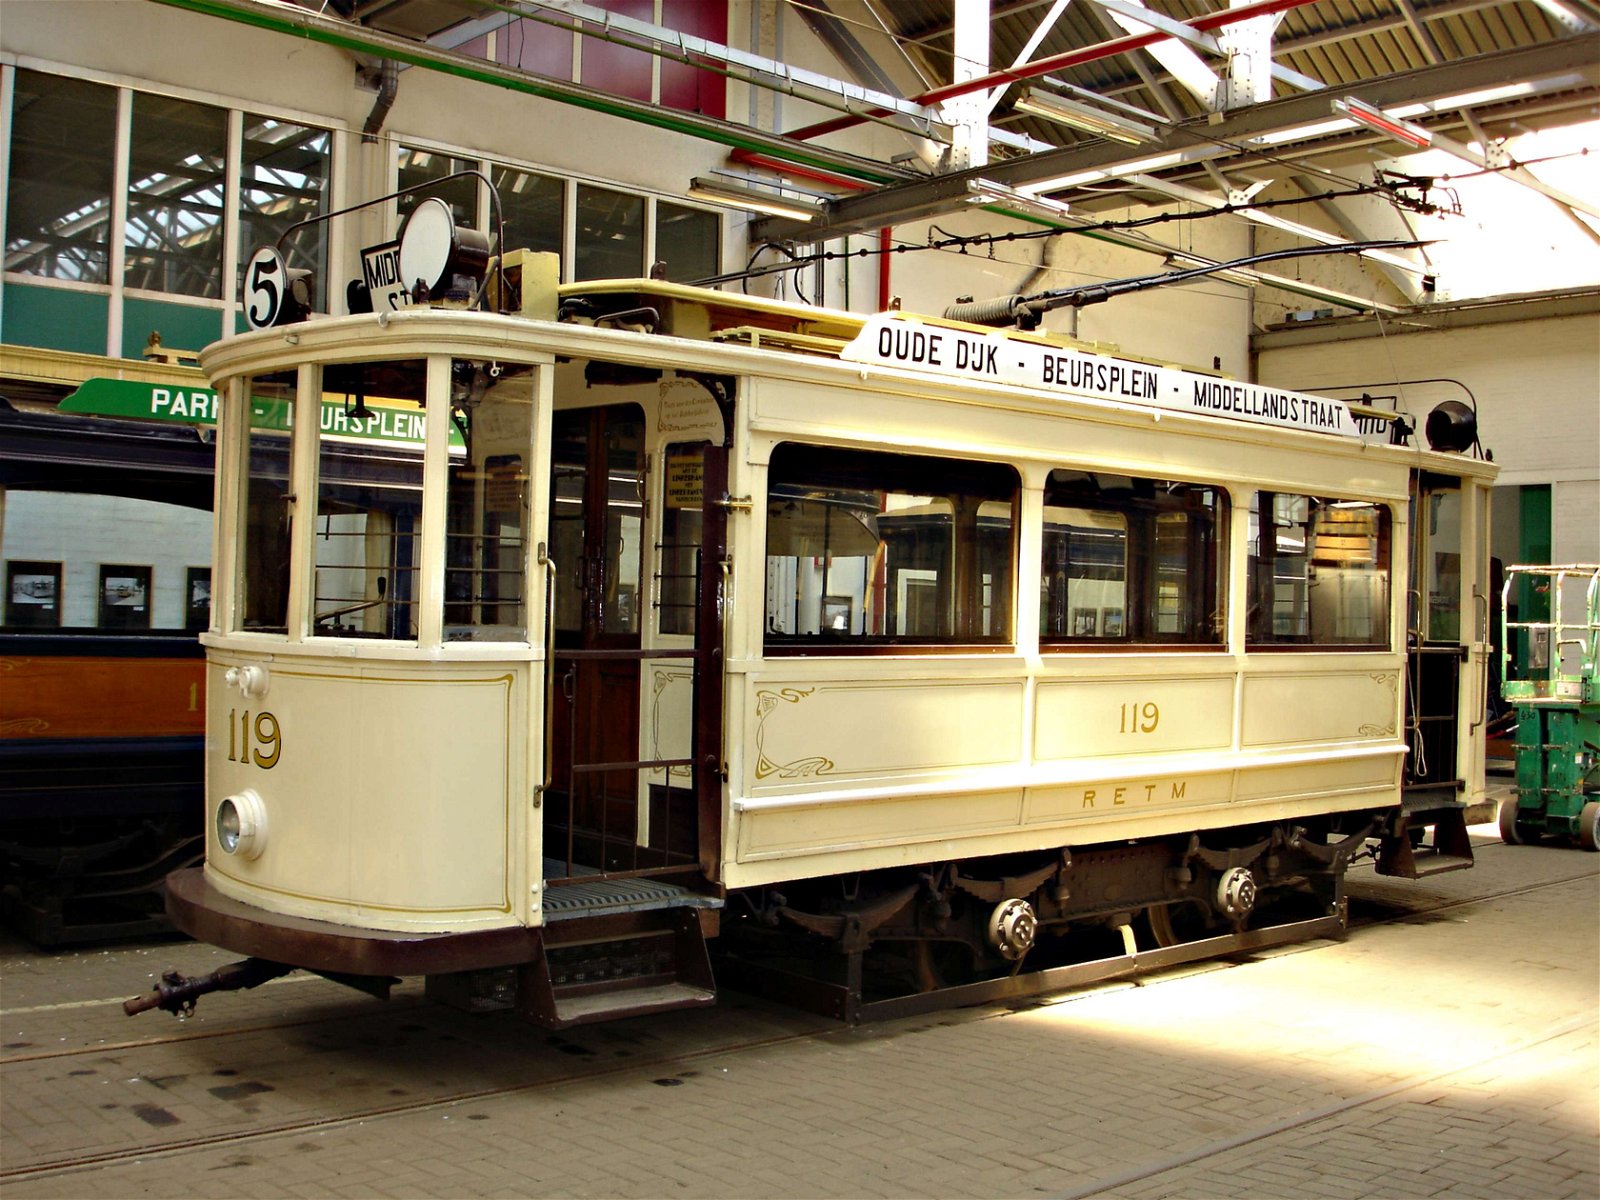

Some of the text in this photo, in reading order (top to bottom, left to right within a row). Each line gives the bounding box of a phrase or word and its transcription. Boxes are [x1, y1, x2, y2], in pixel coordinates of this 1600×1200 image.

[249, 256, 278, 328] 5
[878, 326, 943, 366] OUDE
[1043, 354, 1158, 400] BEURSPLEIN
[1194, 380, 1343, 429] MIDDELLANDSTRAAT
[228, 708, 282, 769] 119
[1120, 702, 1159, 734] 119
